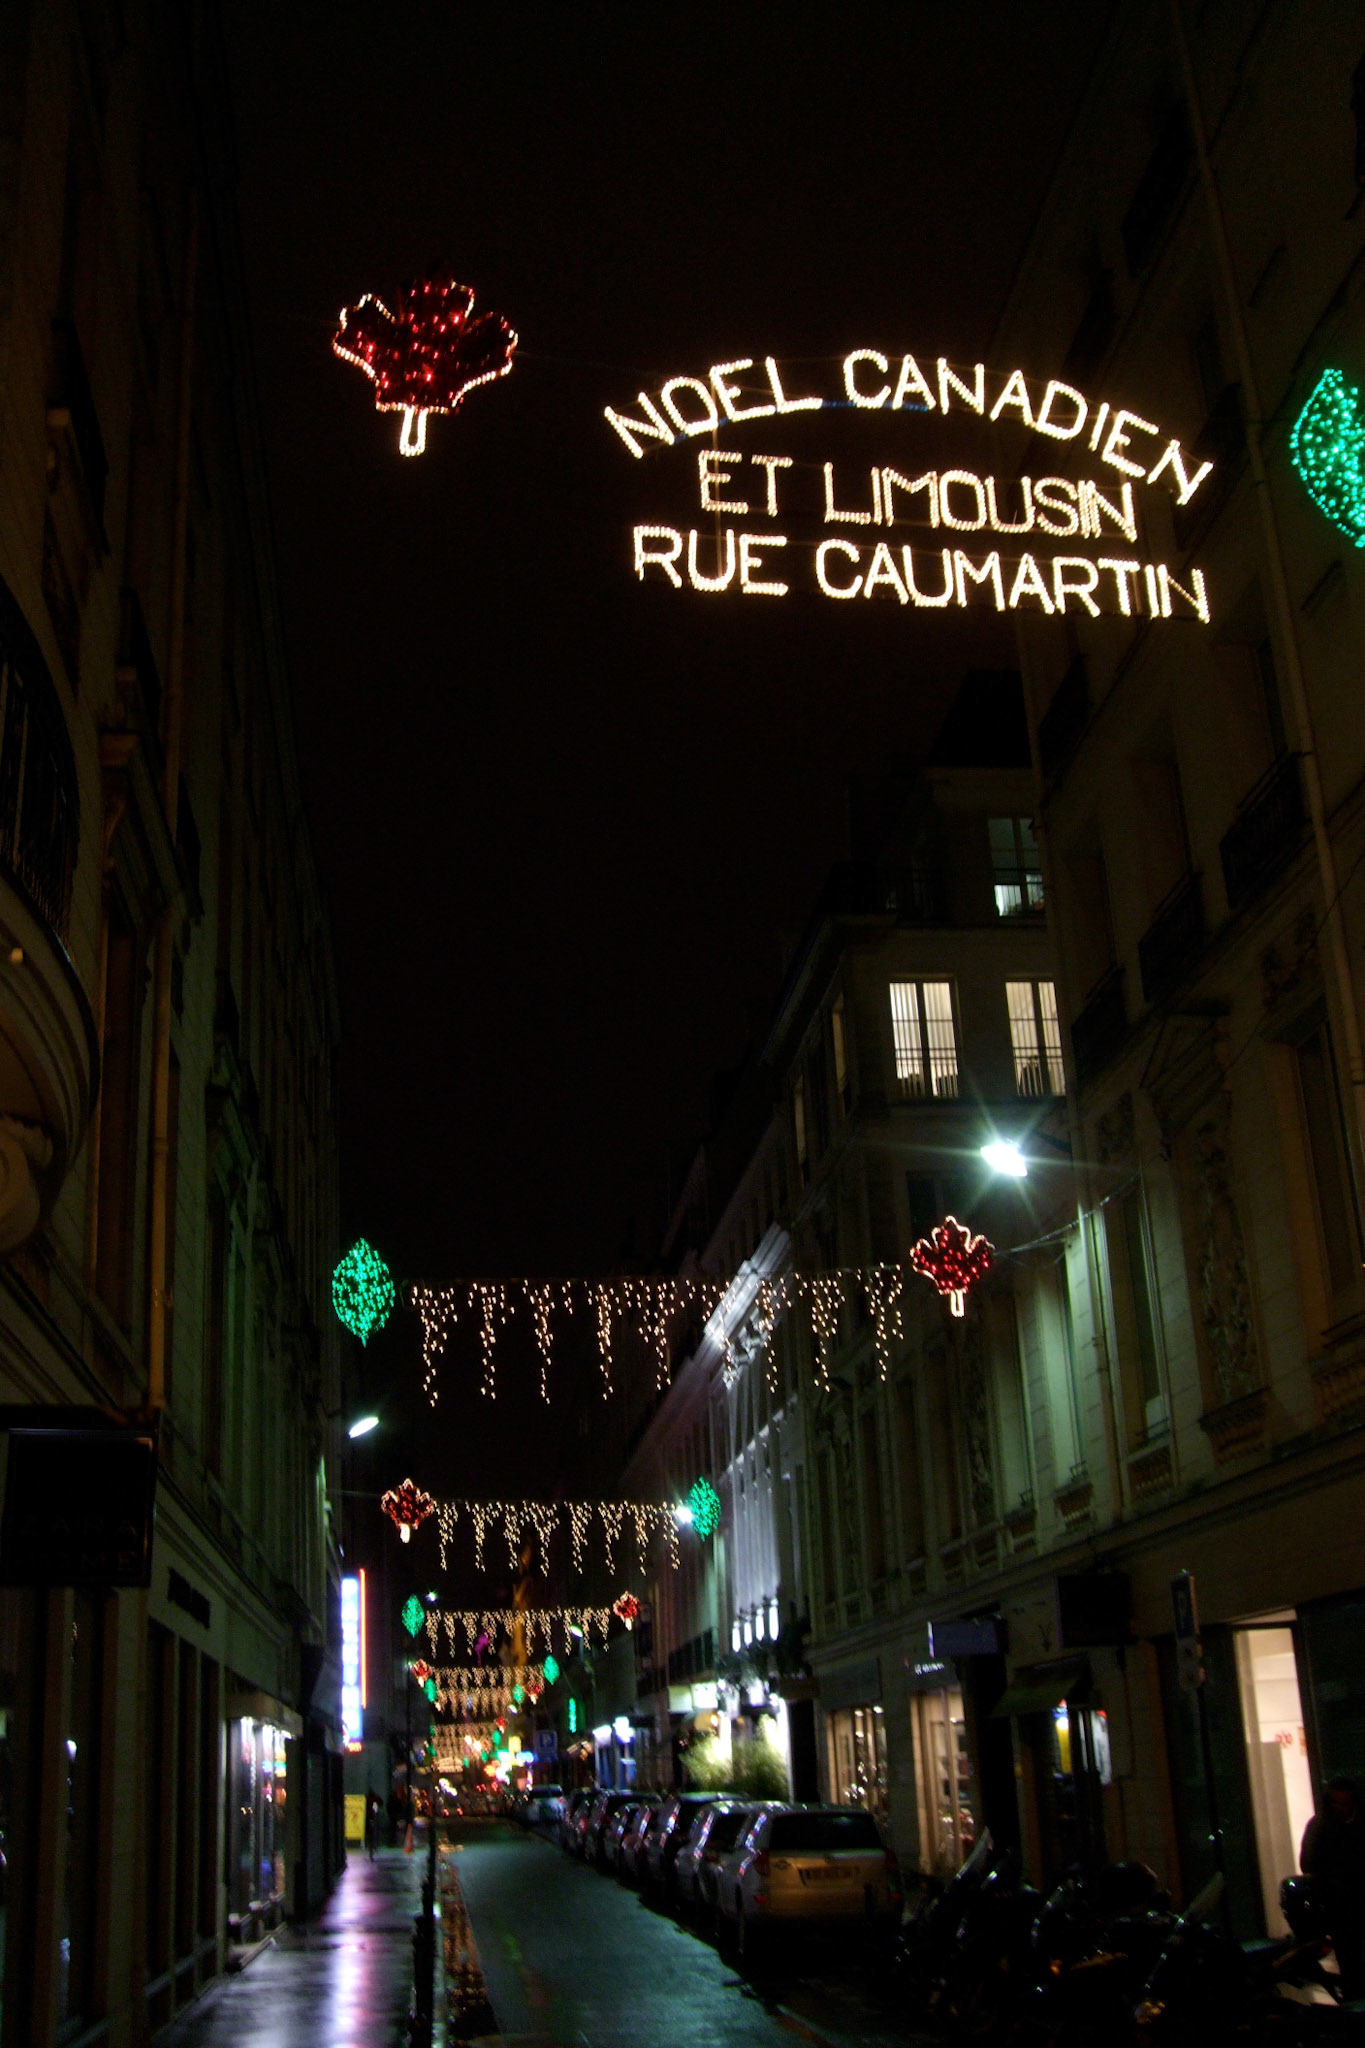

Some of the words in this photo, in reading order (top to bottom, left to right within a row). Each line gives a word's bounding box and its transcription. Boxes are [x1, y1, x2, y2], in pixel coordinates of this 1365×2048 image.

[604, 355, 824, 459] NOEL
[843, 348, 1214, 506] CANADIEN
[698, 449, 793, 517] ET
[823, 461, 1138, 543] LIMOUSIN
[633, 524, 789, 597] RUE
[815, 538, 1211, 624] CAUMARTIN
